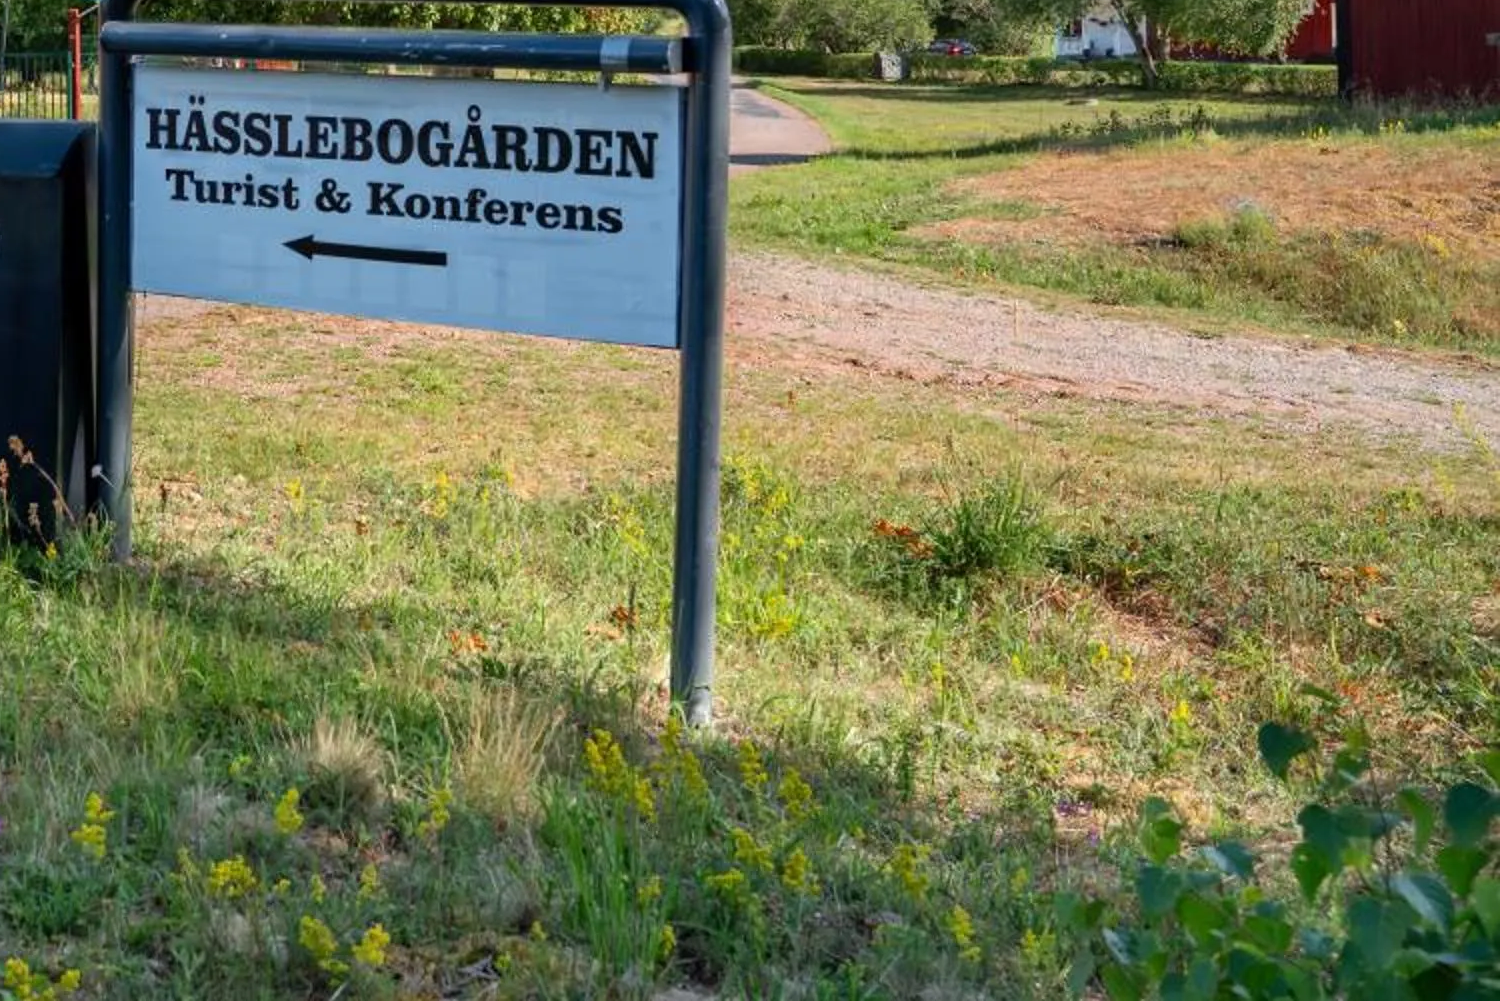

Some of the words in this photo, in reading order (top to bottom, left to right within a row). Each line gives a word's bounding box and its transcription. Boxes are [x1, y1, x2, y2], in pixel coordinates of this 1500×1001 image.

[145, 94, 659, 180] HÄSSLEBOGÅRDEN
[166, 168, 300, 212] Turist
[314, 177, 352, 214] &
[365, 181, 624, 234] Konferens
